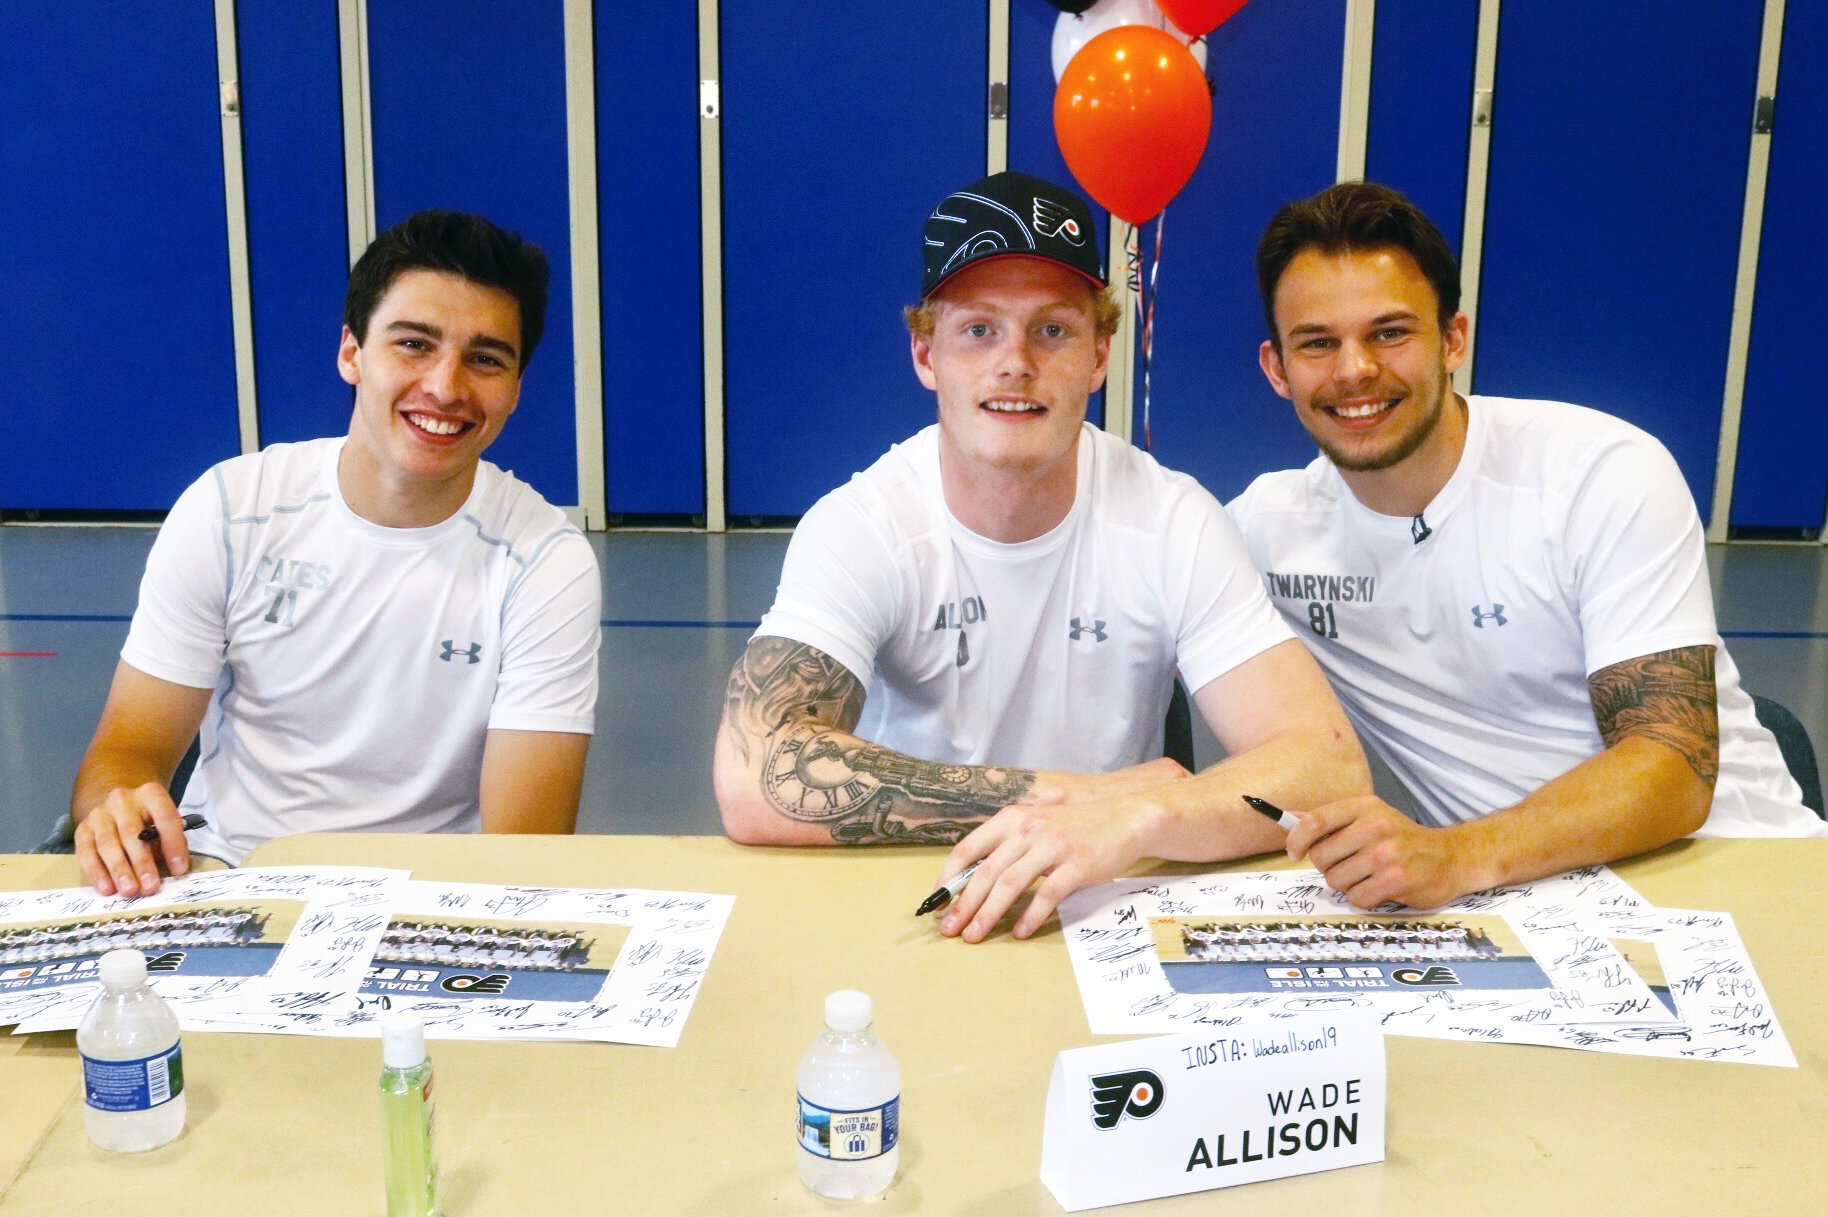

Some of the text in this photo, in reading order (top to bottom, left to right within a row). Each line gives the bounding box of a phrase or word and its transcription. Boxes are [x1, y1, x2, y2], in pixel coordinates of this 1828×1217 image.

[255, 555, 331, 591] CATES
[1266, 571, 1376, 602] TWARYNSKI
[264, 585, 298, 628] 71
[1308, 602, 1339, 639] 81
[376, 981, 430, 992] TRIAL
[1270, 980, 1313, 988] ISLE
[1332, 979, 1391, 988] TRIAL
[1181, 1039, 1247, 1070] INSTA:
[1267, 1079, 1361, 1117] WADE
[833, 1122, 879, 1134] YOUR BAG!
[844, 1116, 860, 1124] FITS
[1185, 1112, 1359, 1173] ALLISON
